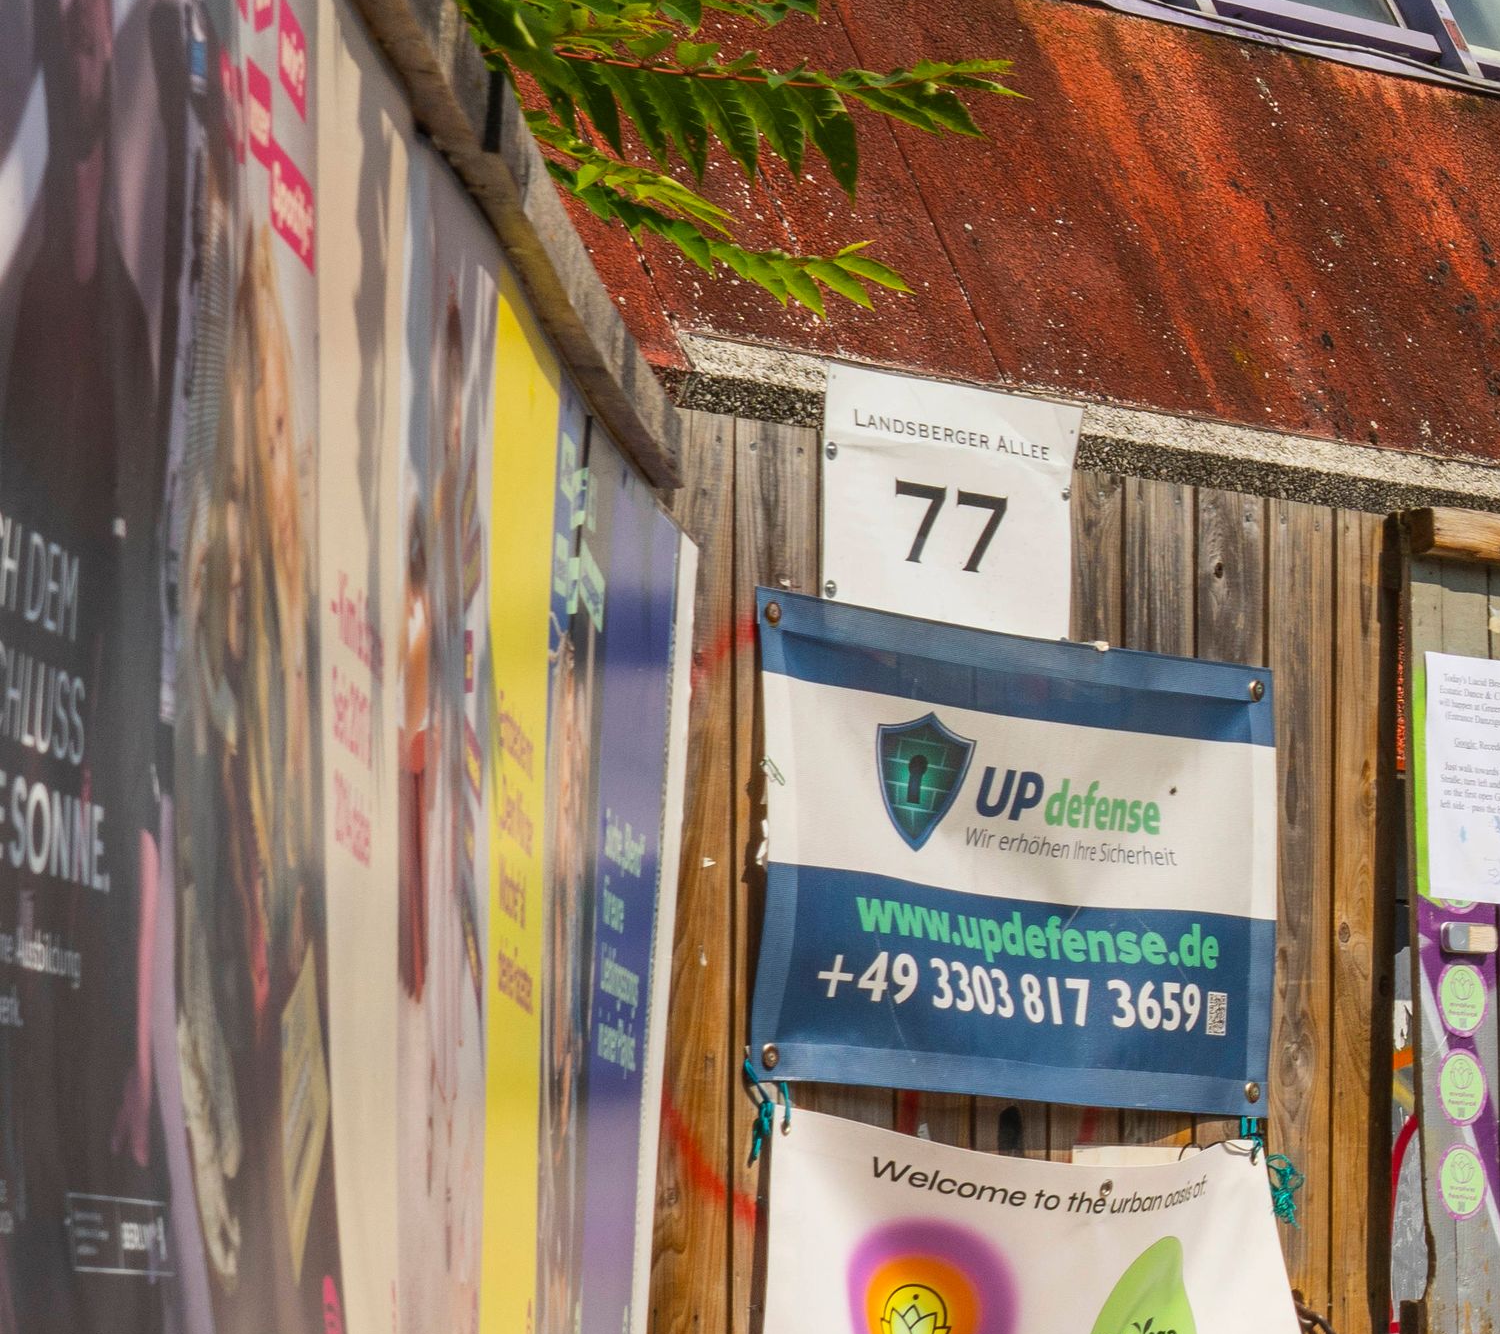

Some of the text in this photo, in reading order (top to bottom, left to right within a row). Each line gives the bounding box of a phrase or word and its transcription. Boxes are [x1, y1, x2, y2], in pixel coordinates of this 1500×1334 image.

[854, 409, 1050, 461] LANDSBERGER ALLEE
[895, 478, 1008, 573] 77
[24, 531, 80, 642] DEM
[965, 826, 1176, 867] Wir erhöhen Ihre Sicherheit
[855, 895, 1220, 970] www.updefense.de
[818, 951, 1201, 1033] +49 3303 817 3659
[872, 1157, 1026, 1207] Welcome
[1033, 1190, 1060, 1210] to
[1067, 1192, 1106, 1214] the
[1110, 1192, 1162, 1214] urban
[1165, 1188, 1192, 1209] oasis
